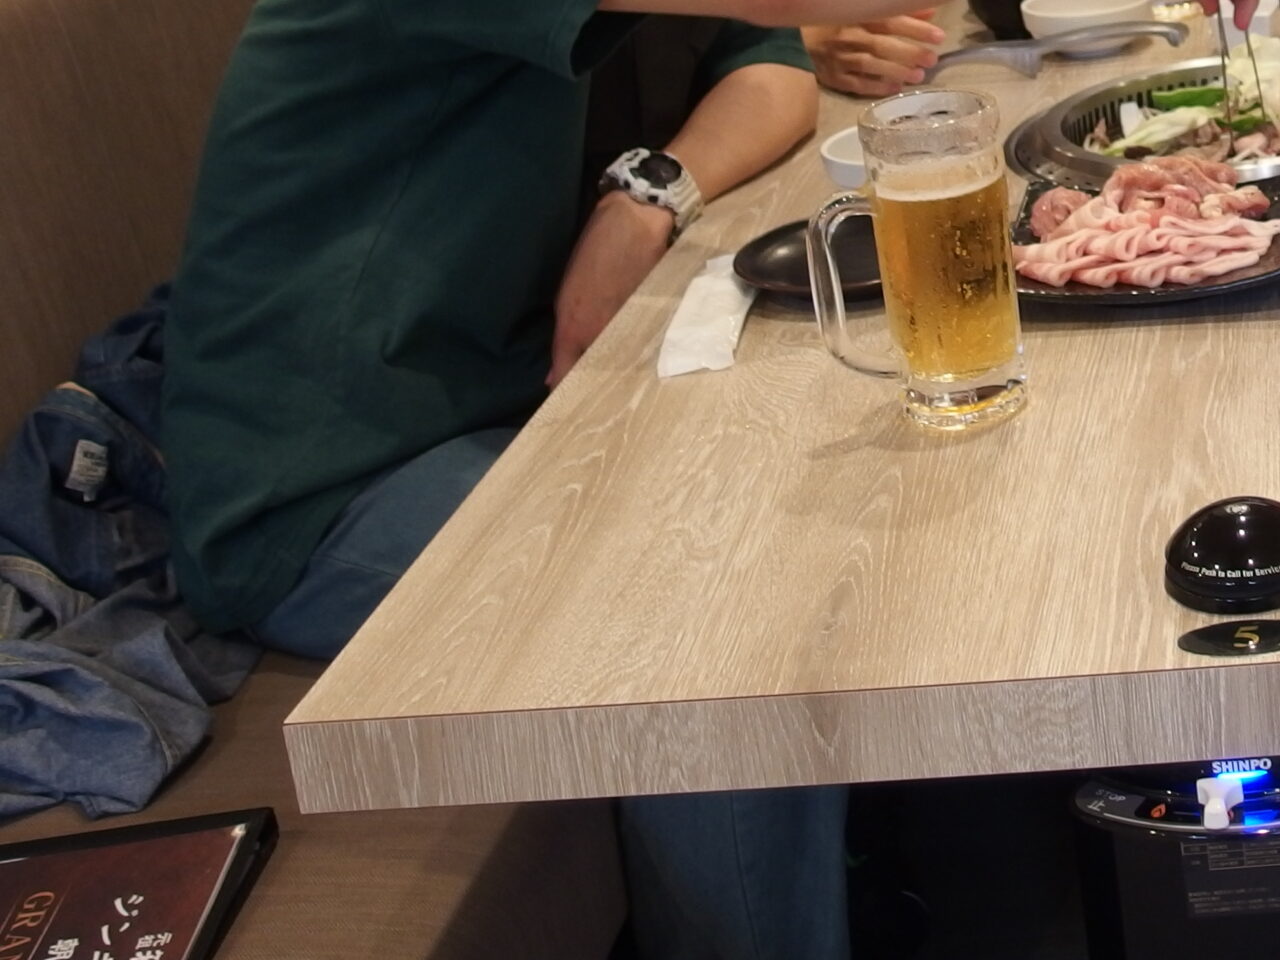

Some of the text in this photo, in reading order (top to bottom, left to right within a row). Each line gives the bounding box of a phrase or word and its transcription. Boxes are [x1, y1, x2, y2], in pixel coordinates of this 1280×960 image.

[1201, 567, 1217, 577] Push
[1218, 568, 1226, 578] to
[1226, 569, 1241, 578] Call
[1242, 568, 1254, 577] for
[1233, 625, 1260, 648] 5
[1212, 758, 1272, 774] SHINPO
[1095, 789, 1127, 802] STOP
[1087, 800, 1106, 812] 止
